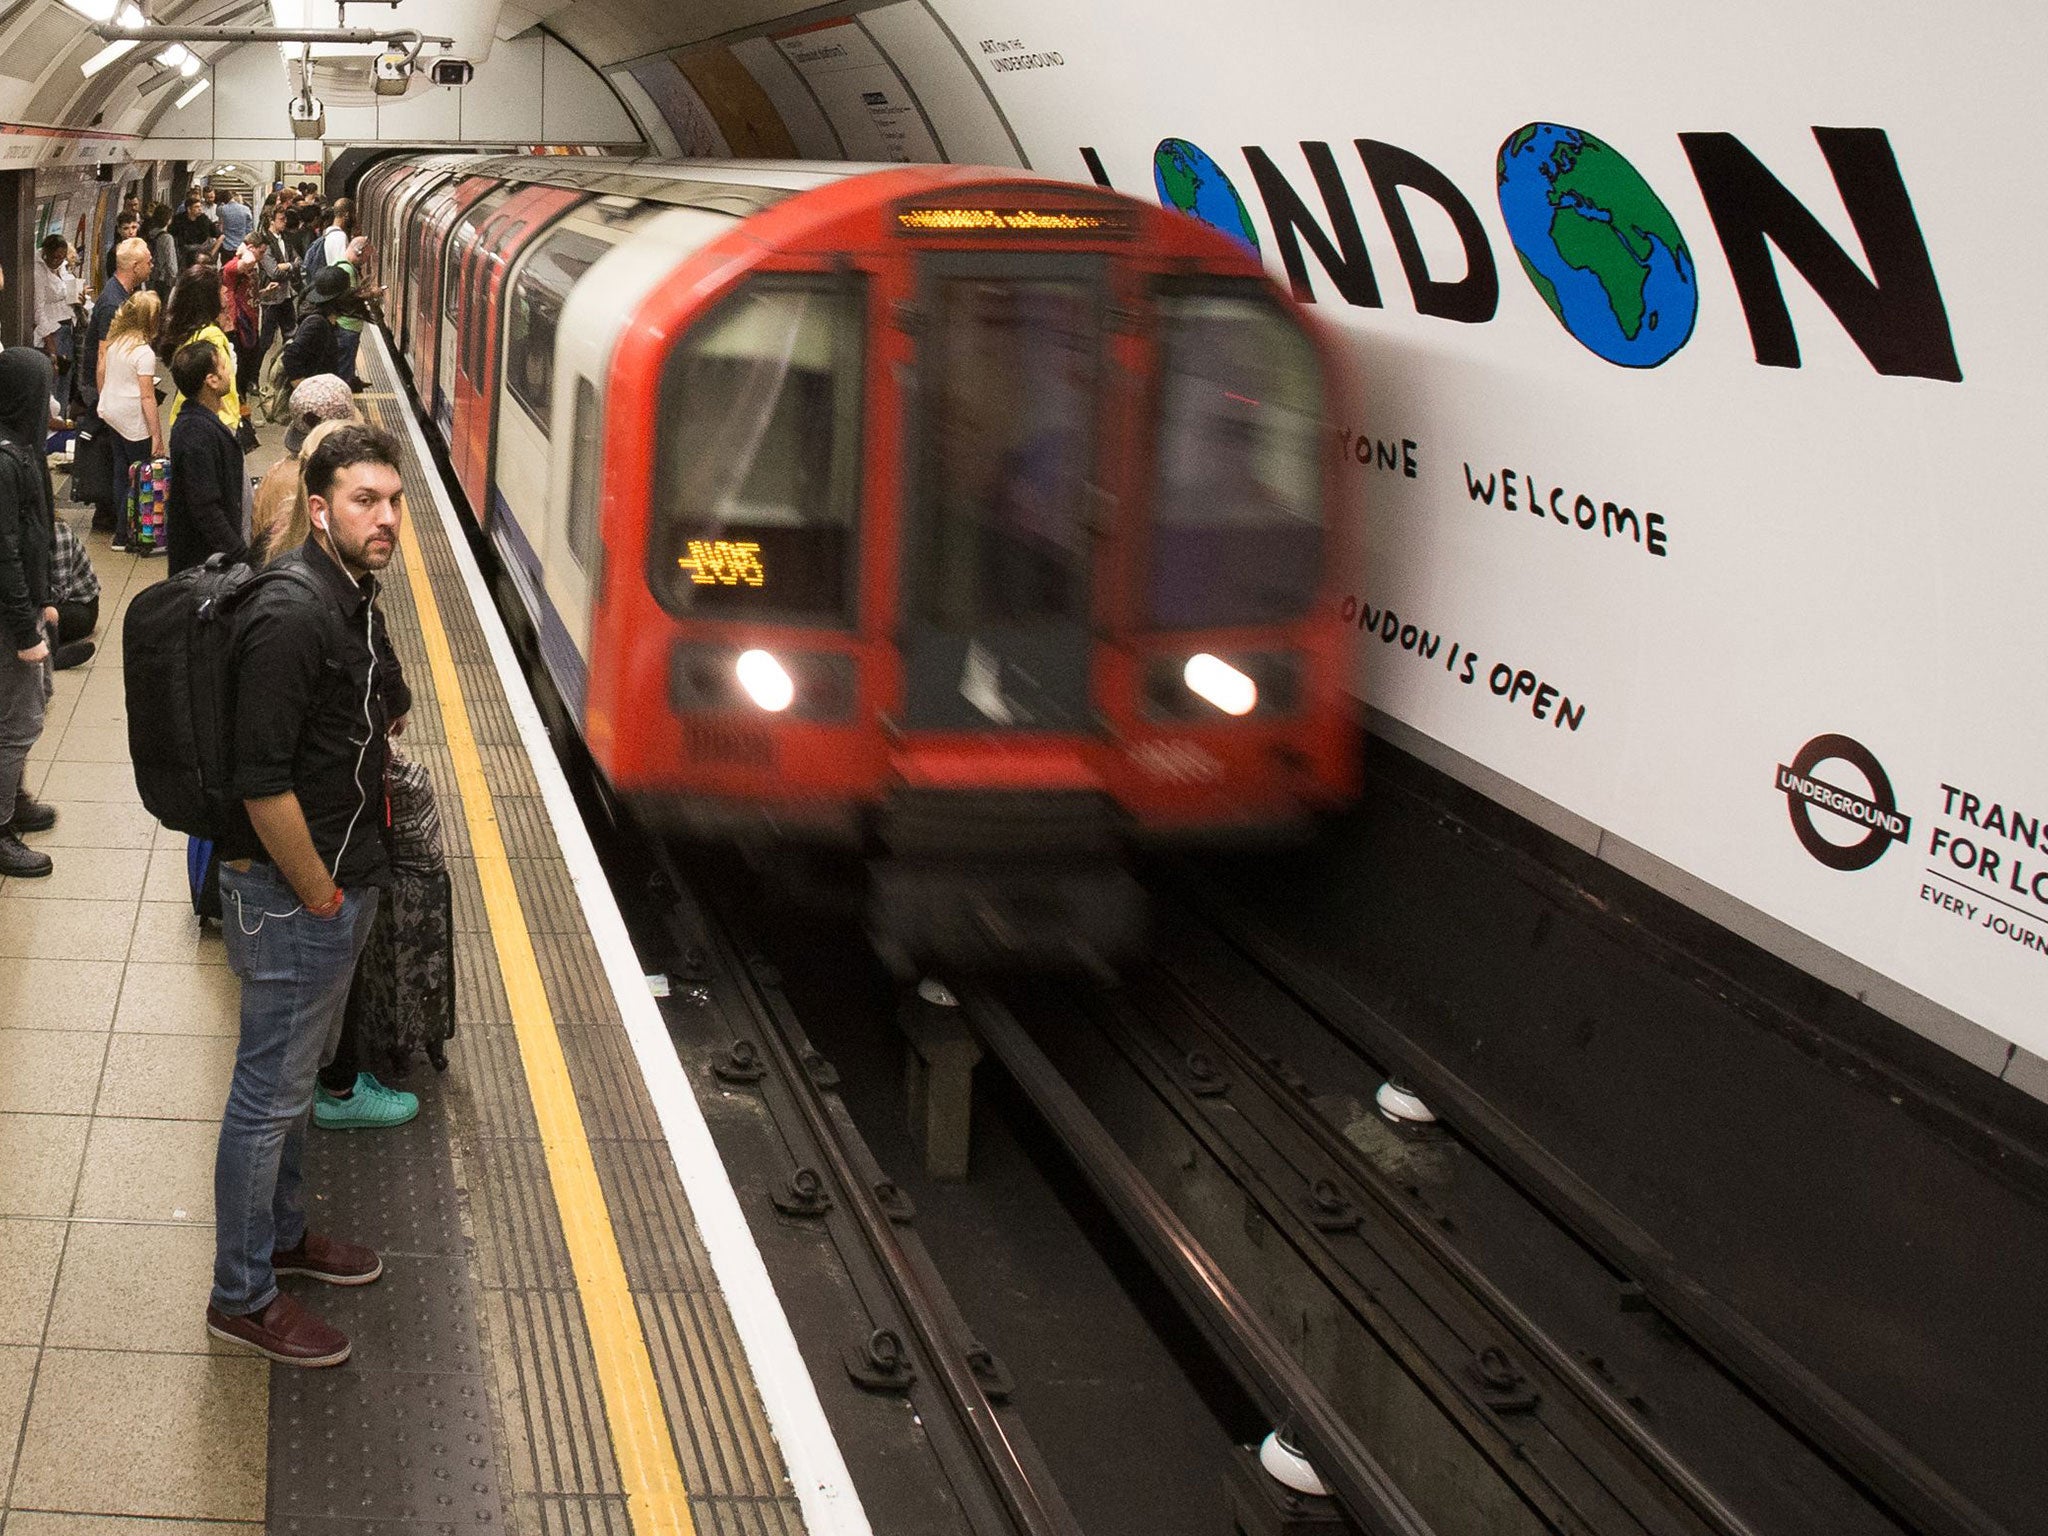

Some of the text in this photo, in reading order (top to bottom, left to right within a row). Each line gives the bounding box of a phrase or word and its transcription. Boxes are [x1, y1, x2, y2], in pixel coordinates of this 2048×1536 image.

[979, 38, 1026, 55] ART ON THE
[990, 51, 1066, 73] UNDERGROUND
[1463, 461, 1668, 557] WELCOME
[1446, 642, 1478, 684] IS
[1489, 662, 1586, 732] OPEN
[1780, 770, 1905, 835] UNDERGROUND
[1929, 826, 2000, 884] FOR
[1919, 883, 1978, 921] EVERY
